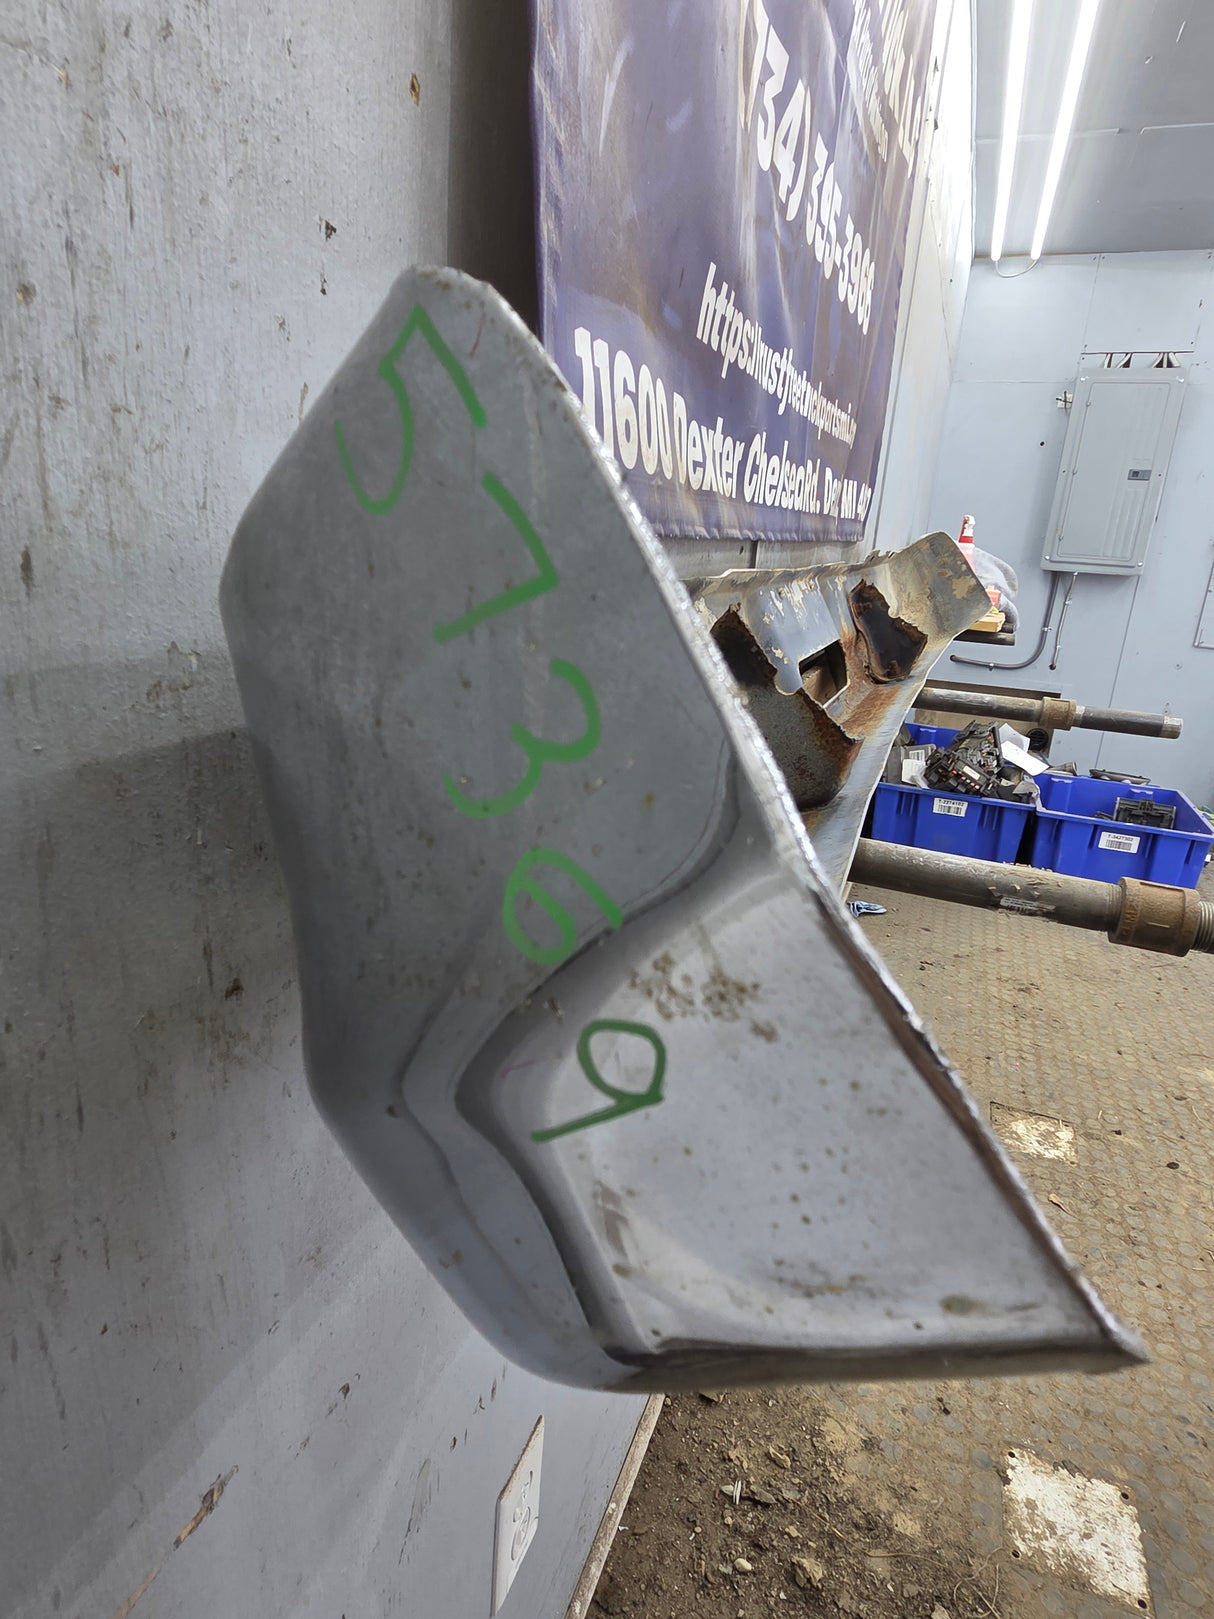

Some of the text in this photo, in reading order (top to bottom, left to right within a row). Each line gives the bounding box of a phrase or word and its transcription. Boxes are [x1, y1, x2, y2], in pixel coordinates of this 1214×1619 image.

[805, 132, 875, 336] 395-3966
[574, 326, 673, 480] 11600
[673, 391, 745, 499] Dexter
[840, 479, 857, 519] MI
